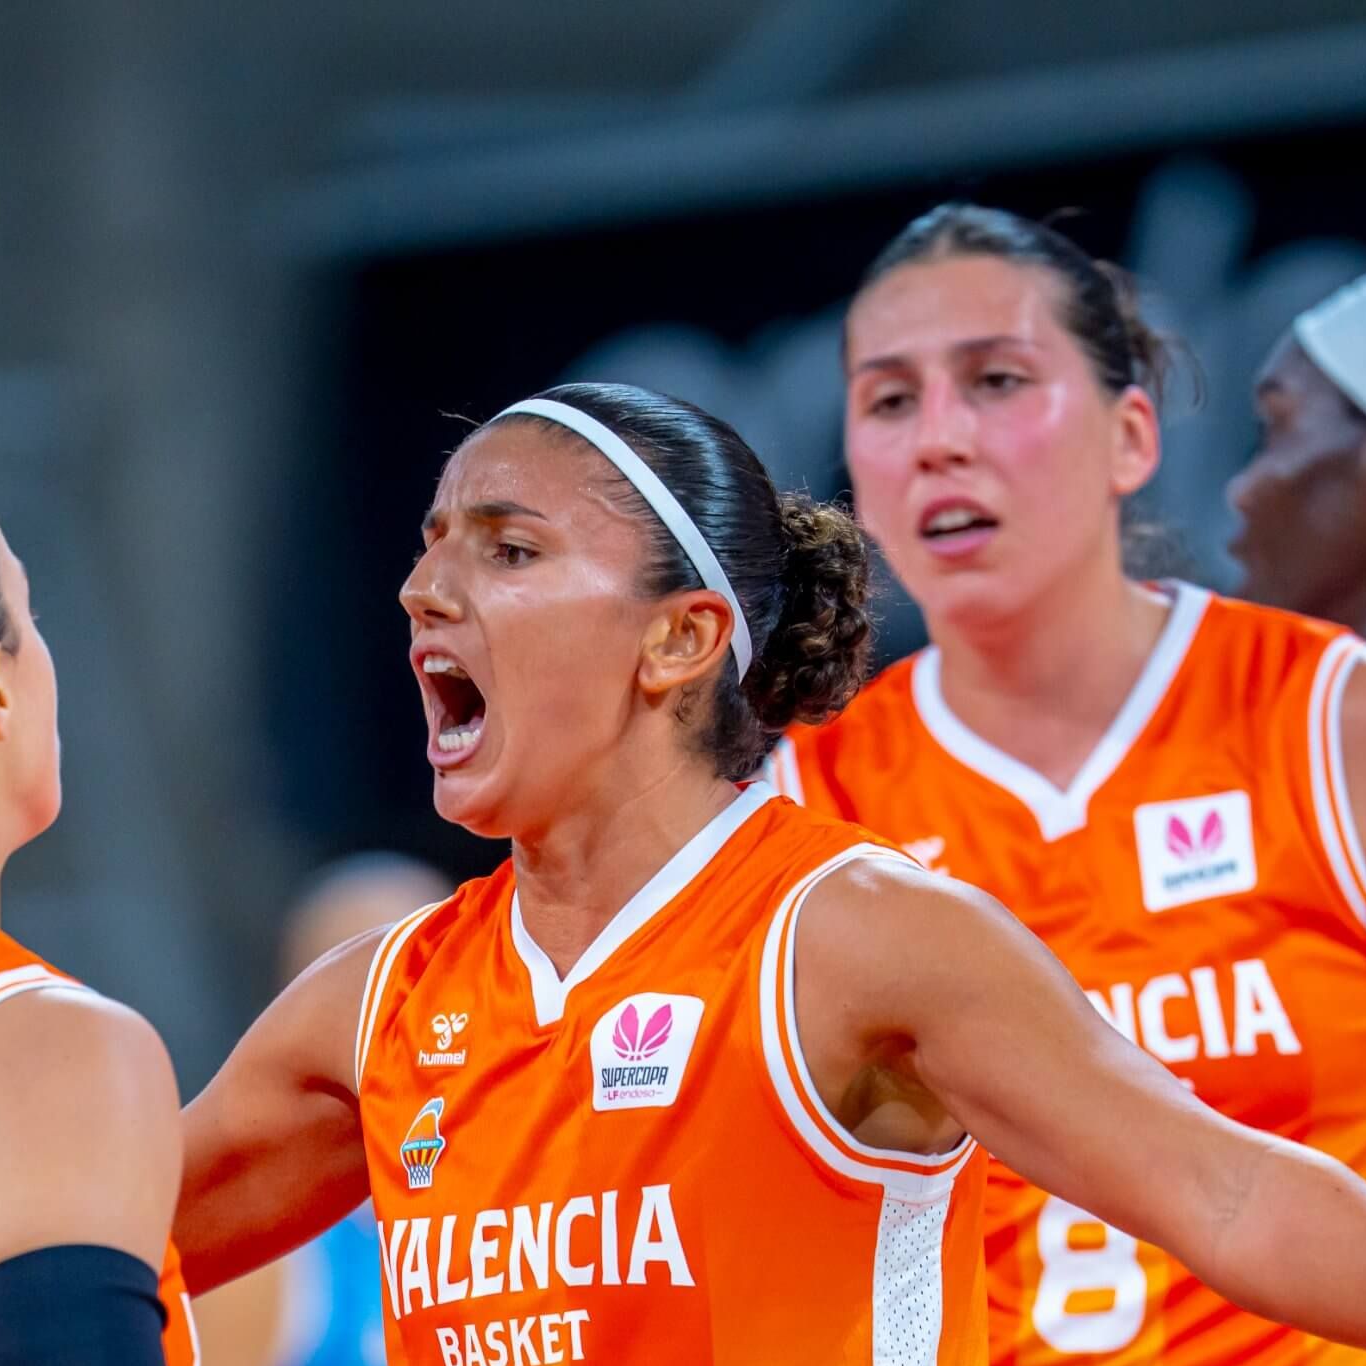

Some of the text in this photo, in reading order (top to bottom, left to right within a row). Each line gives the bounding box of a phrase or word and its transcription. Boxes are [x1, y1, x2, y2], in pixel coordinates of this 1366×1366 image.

[418, 1049, 466, 1066] hummel
[1085, 958, 1302, 1064] NCIA
[601, 1066, 669, 1088] SUPERCOPA
[377, 1184, 696, 1321] VALENCIA
[1032, 1190, 1148, 1354] 8
